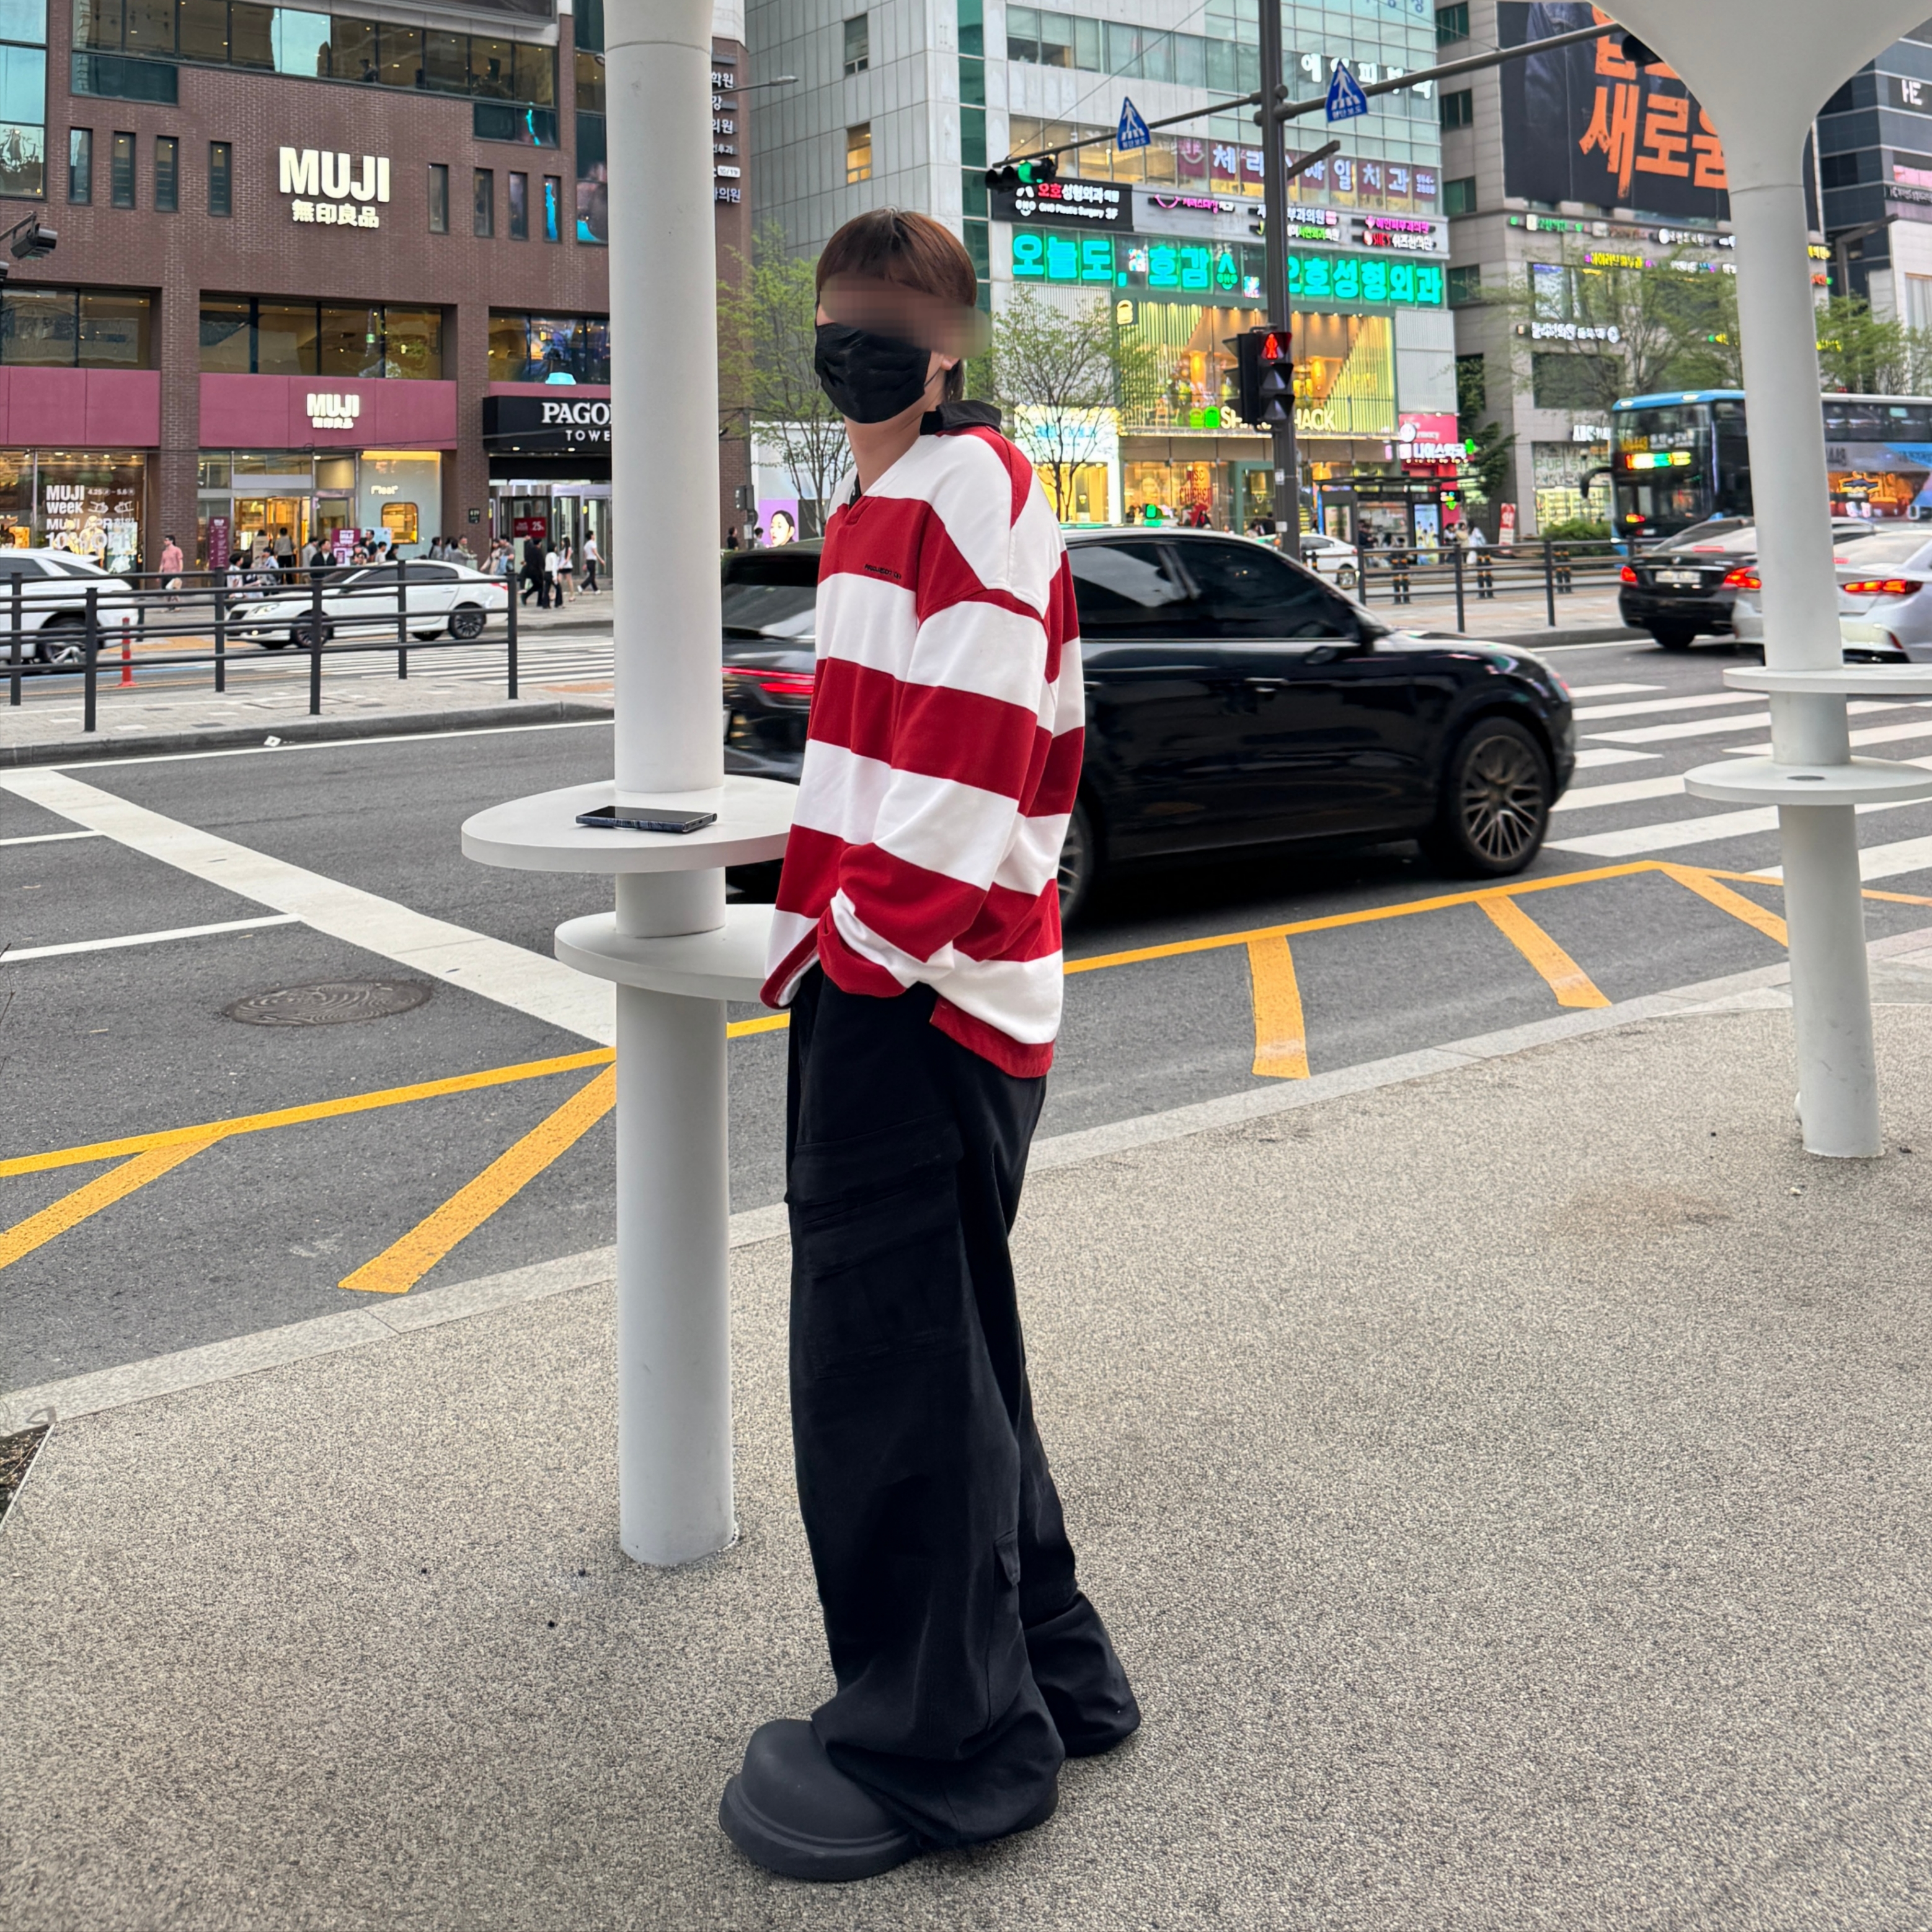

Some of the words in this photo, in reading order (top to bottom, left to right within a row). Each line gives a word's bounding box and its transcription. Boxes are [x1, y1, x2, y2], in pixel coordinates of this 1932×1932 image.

[279, 146, 390, 203] MUJI
[715, 187, 741, 203] 의원
[291, 198, 379, 228] 無印良品
[1012, 234, 1127, 287] 오늘도,
[1148, 244, 1210, 288] 호감
[306, 393, 360, 417] MUJI
[541, 402, 611, 425] PAGO
[565, 430, 610, 442] TOWE
[46, 485, 85, 501] MUJI
[46, 502, 84, 514] week
